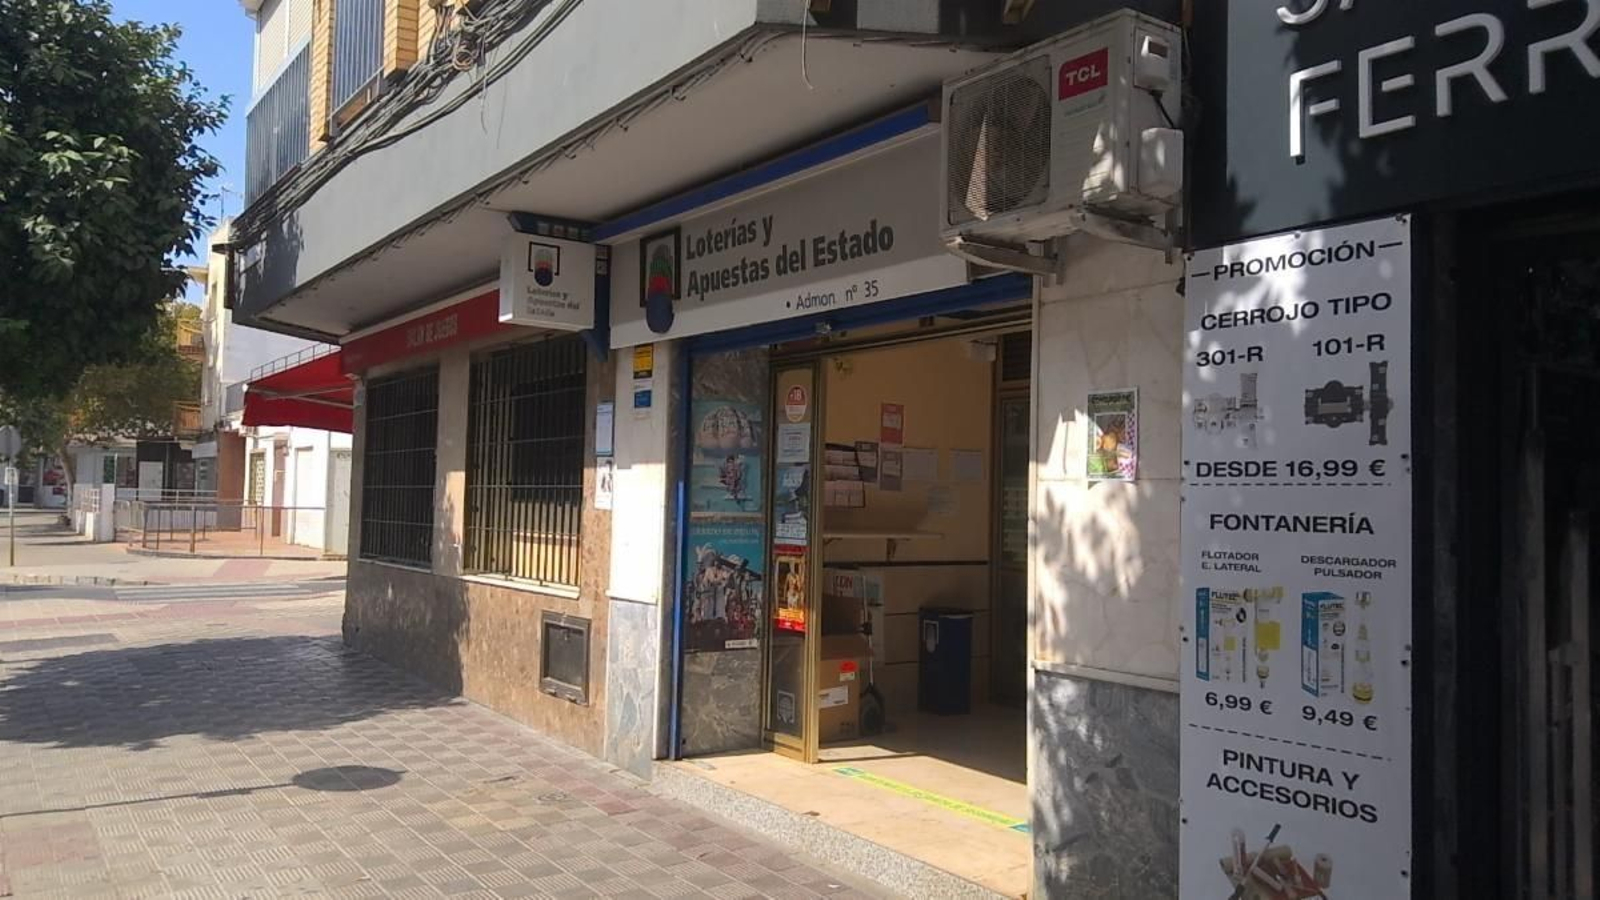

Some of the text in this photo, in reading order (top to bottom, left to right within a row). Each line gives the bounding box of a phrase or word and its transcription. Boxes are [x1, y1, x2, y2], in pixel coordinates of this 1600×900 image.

[1066, 65, 1100, 86] TCL
[686, 214, 773, 260] Loterías y
[687, 219, 894, 300] Apuestas del Estado
[1213, 240, 1375, 281] PROMOCIÓN
[796, 290, 836, 311] Admon
[864, 280, 879, 298] 35
[1200, 292, 1393, 332] CERROJO TIPO
[1196, 346, 1264, 367] 301-R
[1312, 334, 1386, 357] 101-R
[1196, 459, 1386, 480] DESDE 16,99 €
[1209, 512, 1375, 535] FONTANERÍA
[1201, 551, 1260, 562] FLOTADOR
[1201, 562, 1262, 573] E. LATERAL
[1300, 555, 1397, 569] DESCARGADOR
[1314, 568, 1383, 580] PULSADOR
[1205, 692, 1273, 715] 6,99 €
[1302, 706, 1378, 731] 9,49 €
[1223, 750, 1360, 790] PINTURA Y
[1206, 773, 1378, 824] ACCESORIOS
